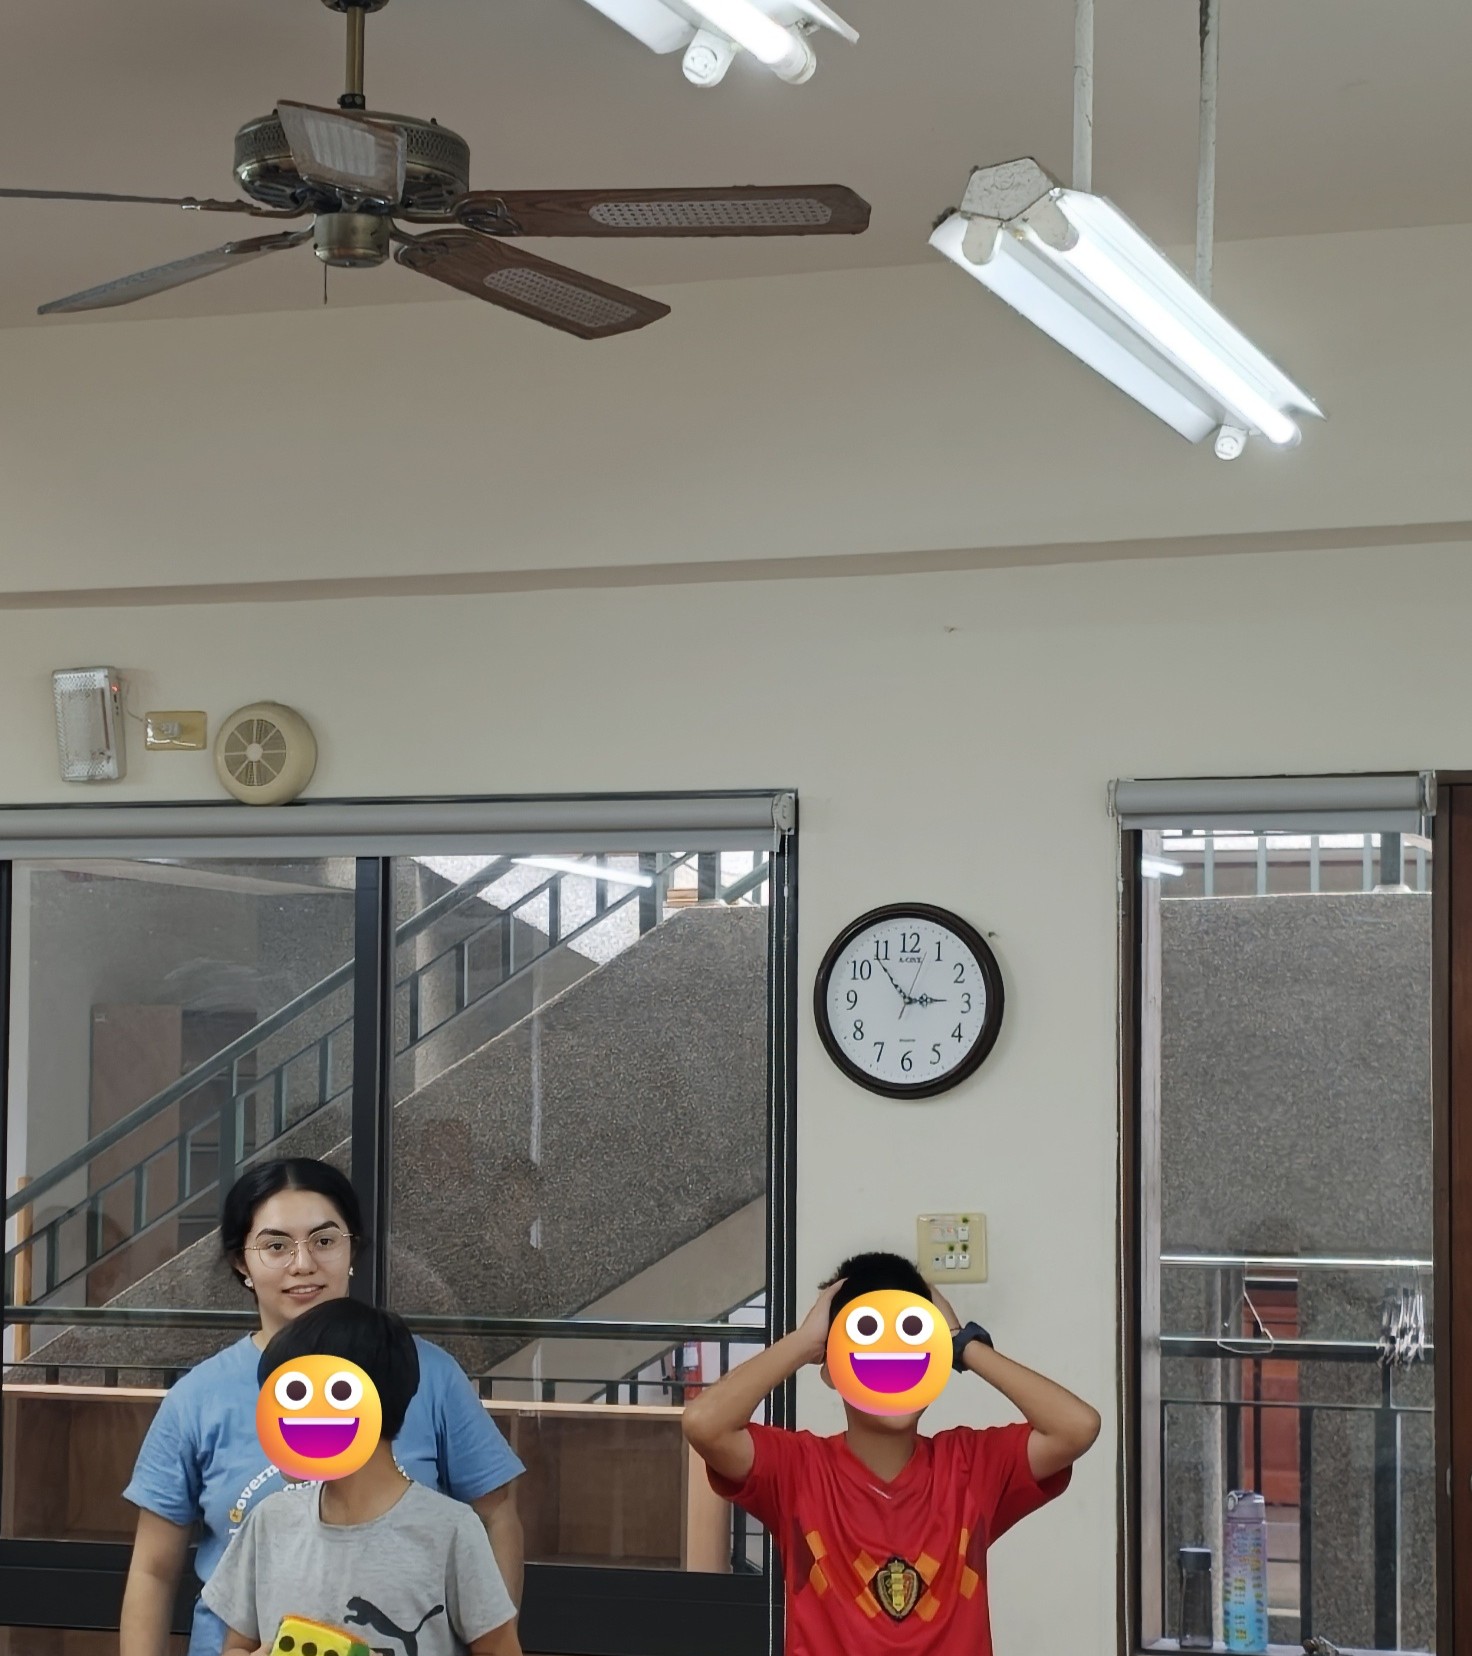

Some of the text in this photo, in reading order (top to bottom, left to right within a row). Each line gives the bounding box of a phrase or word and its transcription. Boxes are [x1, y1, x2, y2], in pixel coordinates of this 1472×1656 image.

[874, 940, 890, 961] 11
[900, 932, 921, 953] 12
[934, 941, 943, 961] 1
[851, 960, 872, 980] 10
[953, 963, 965, 984] 2
[846, 990, 858, 1010] 9
[960, 993, 971, 1014] 3
[852, 1019, 864, 1041] 8
[951, 1022, 963, 1043] 4
[873, 1042, 885, 1062] 7
[901, 1050, 913, 1071] 6
[930, 1043, 941, 1065] 5
[229, 1464, 279, 1523] Govern
